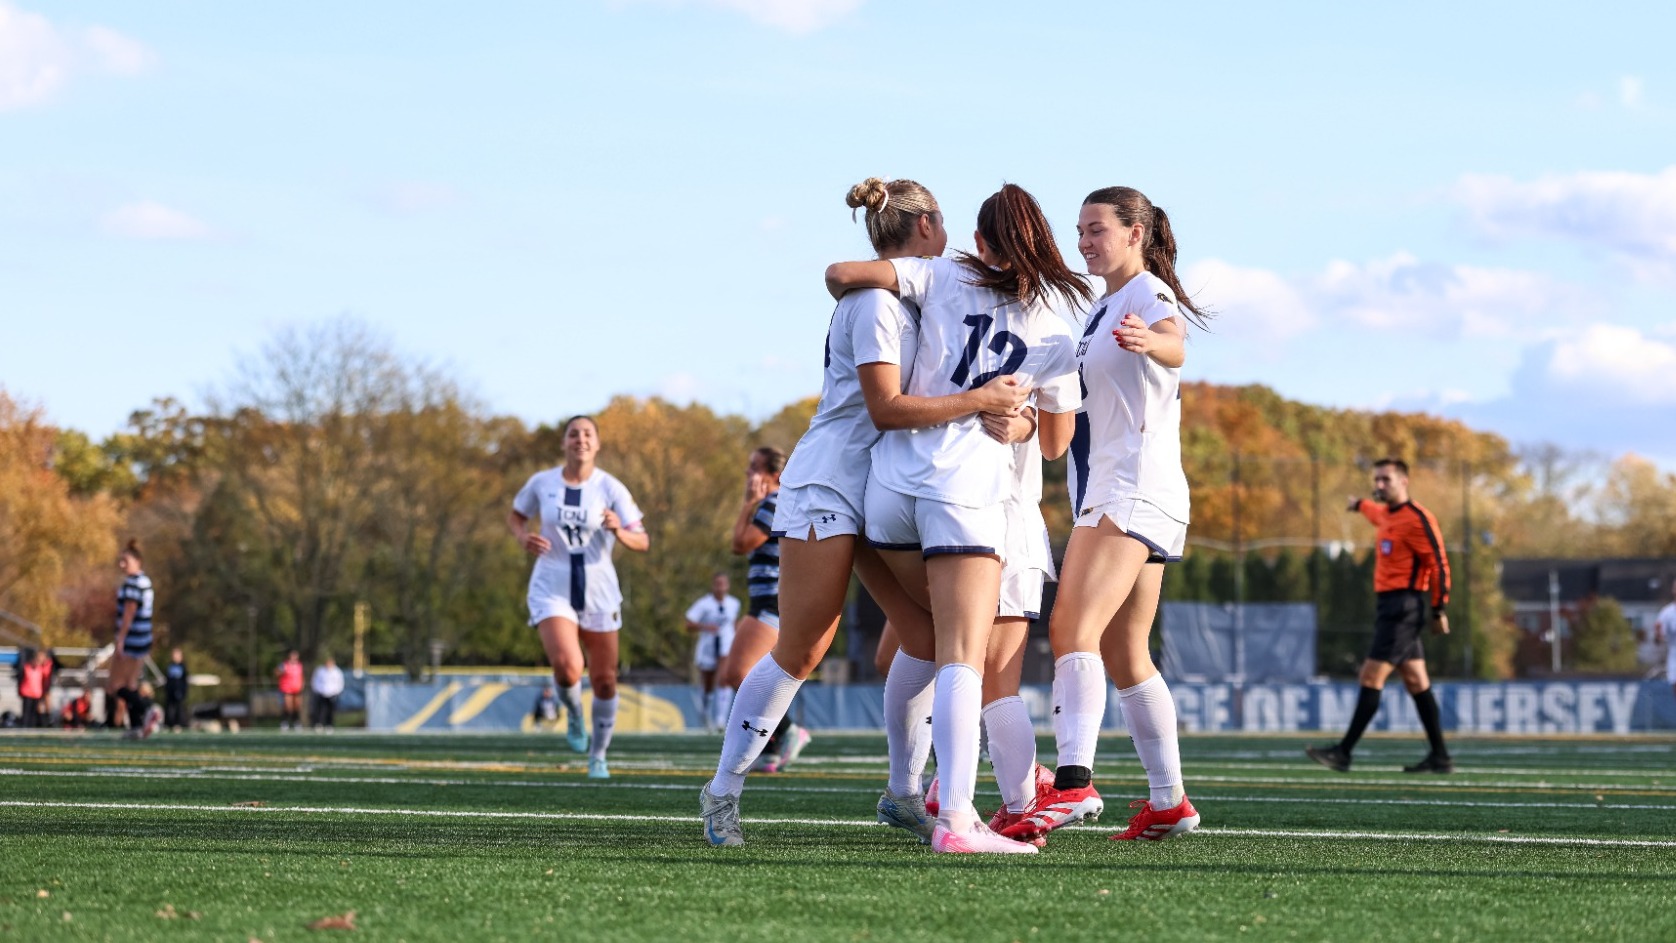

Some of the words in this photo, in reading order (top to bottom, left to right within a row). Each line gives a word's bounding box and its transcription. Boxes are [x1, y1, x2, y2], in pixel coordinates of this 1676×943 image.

[949, 313, 1028, 391] 12
[1242, 684, 1310, 732] OF
[1456, 682, 1640, 734] JERSEY
